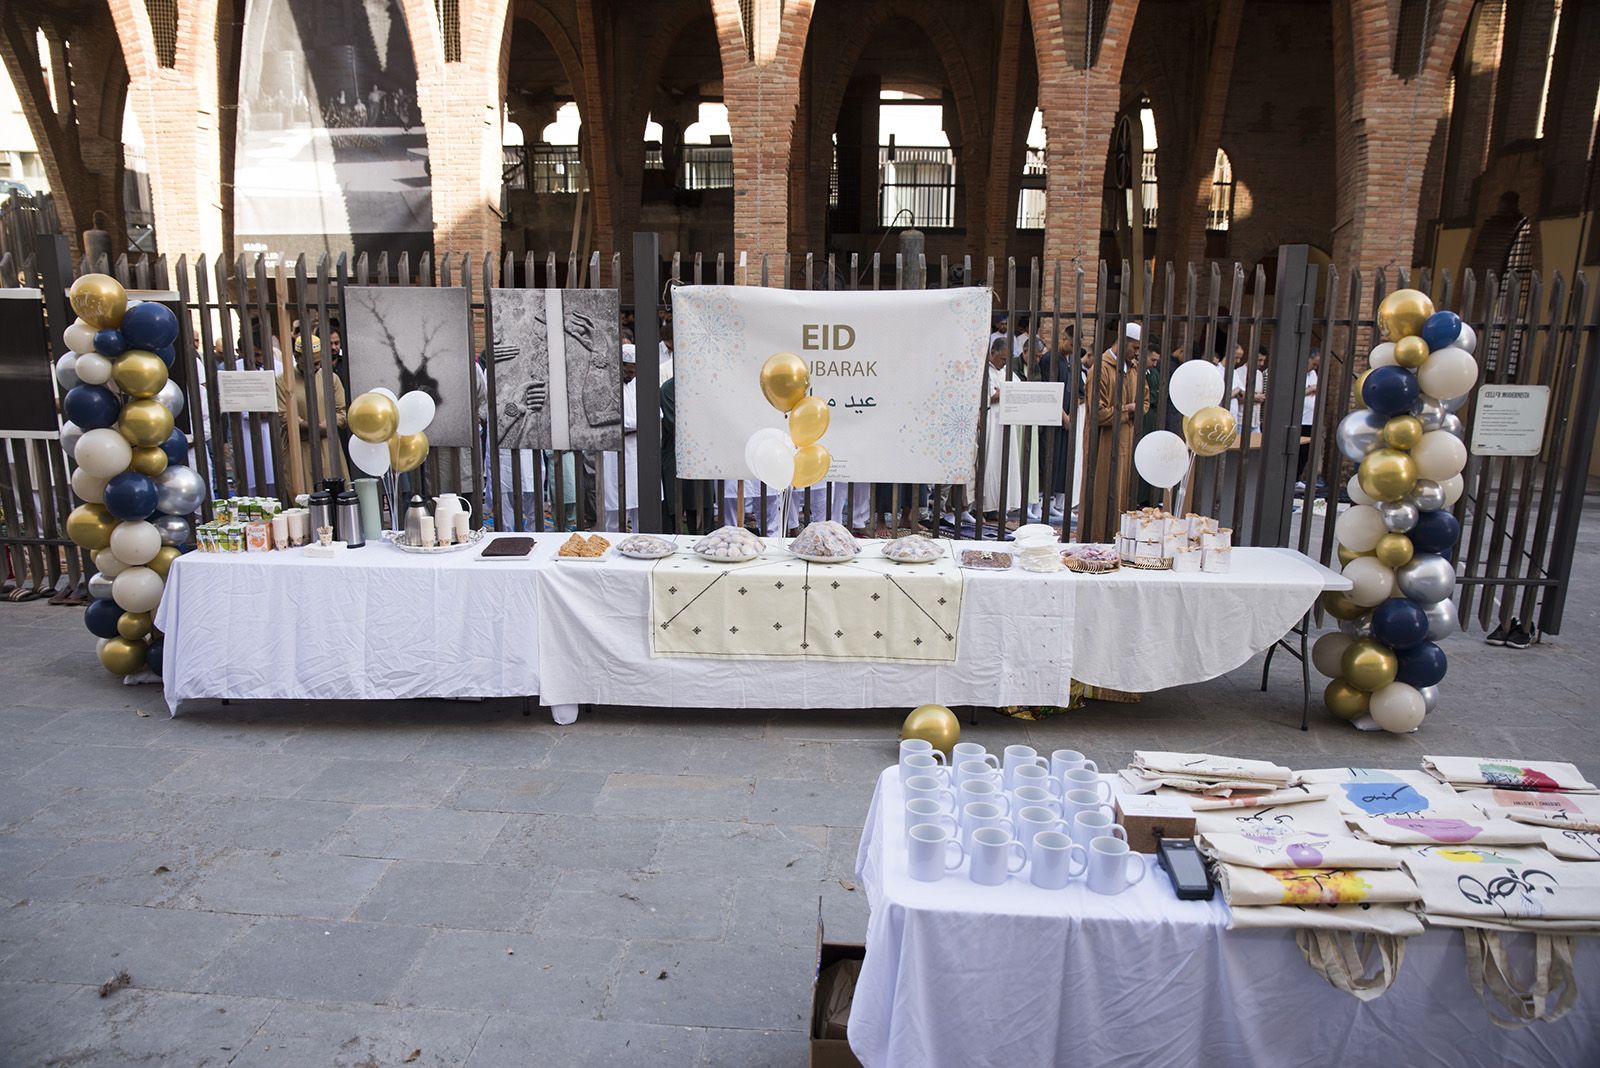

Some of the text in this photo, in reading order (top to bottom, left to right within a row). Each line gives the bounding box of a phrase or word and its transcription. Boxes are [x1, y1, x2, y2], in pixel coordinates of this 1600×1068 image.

[802, 324, 856, 350] EID
[810, 360, 878, 377] BARAK
[844, 395, 877, 414] عيد
[1207, 423, 1237, 445] Eid
